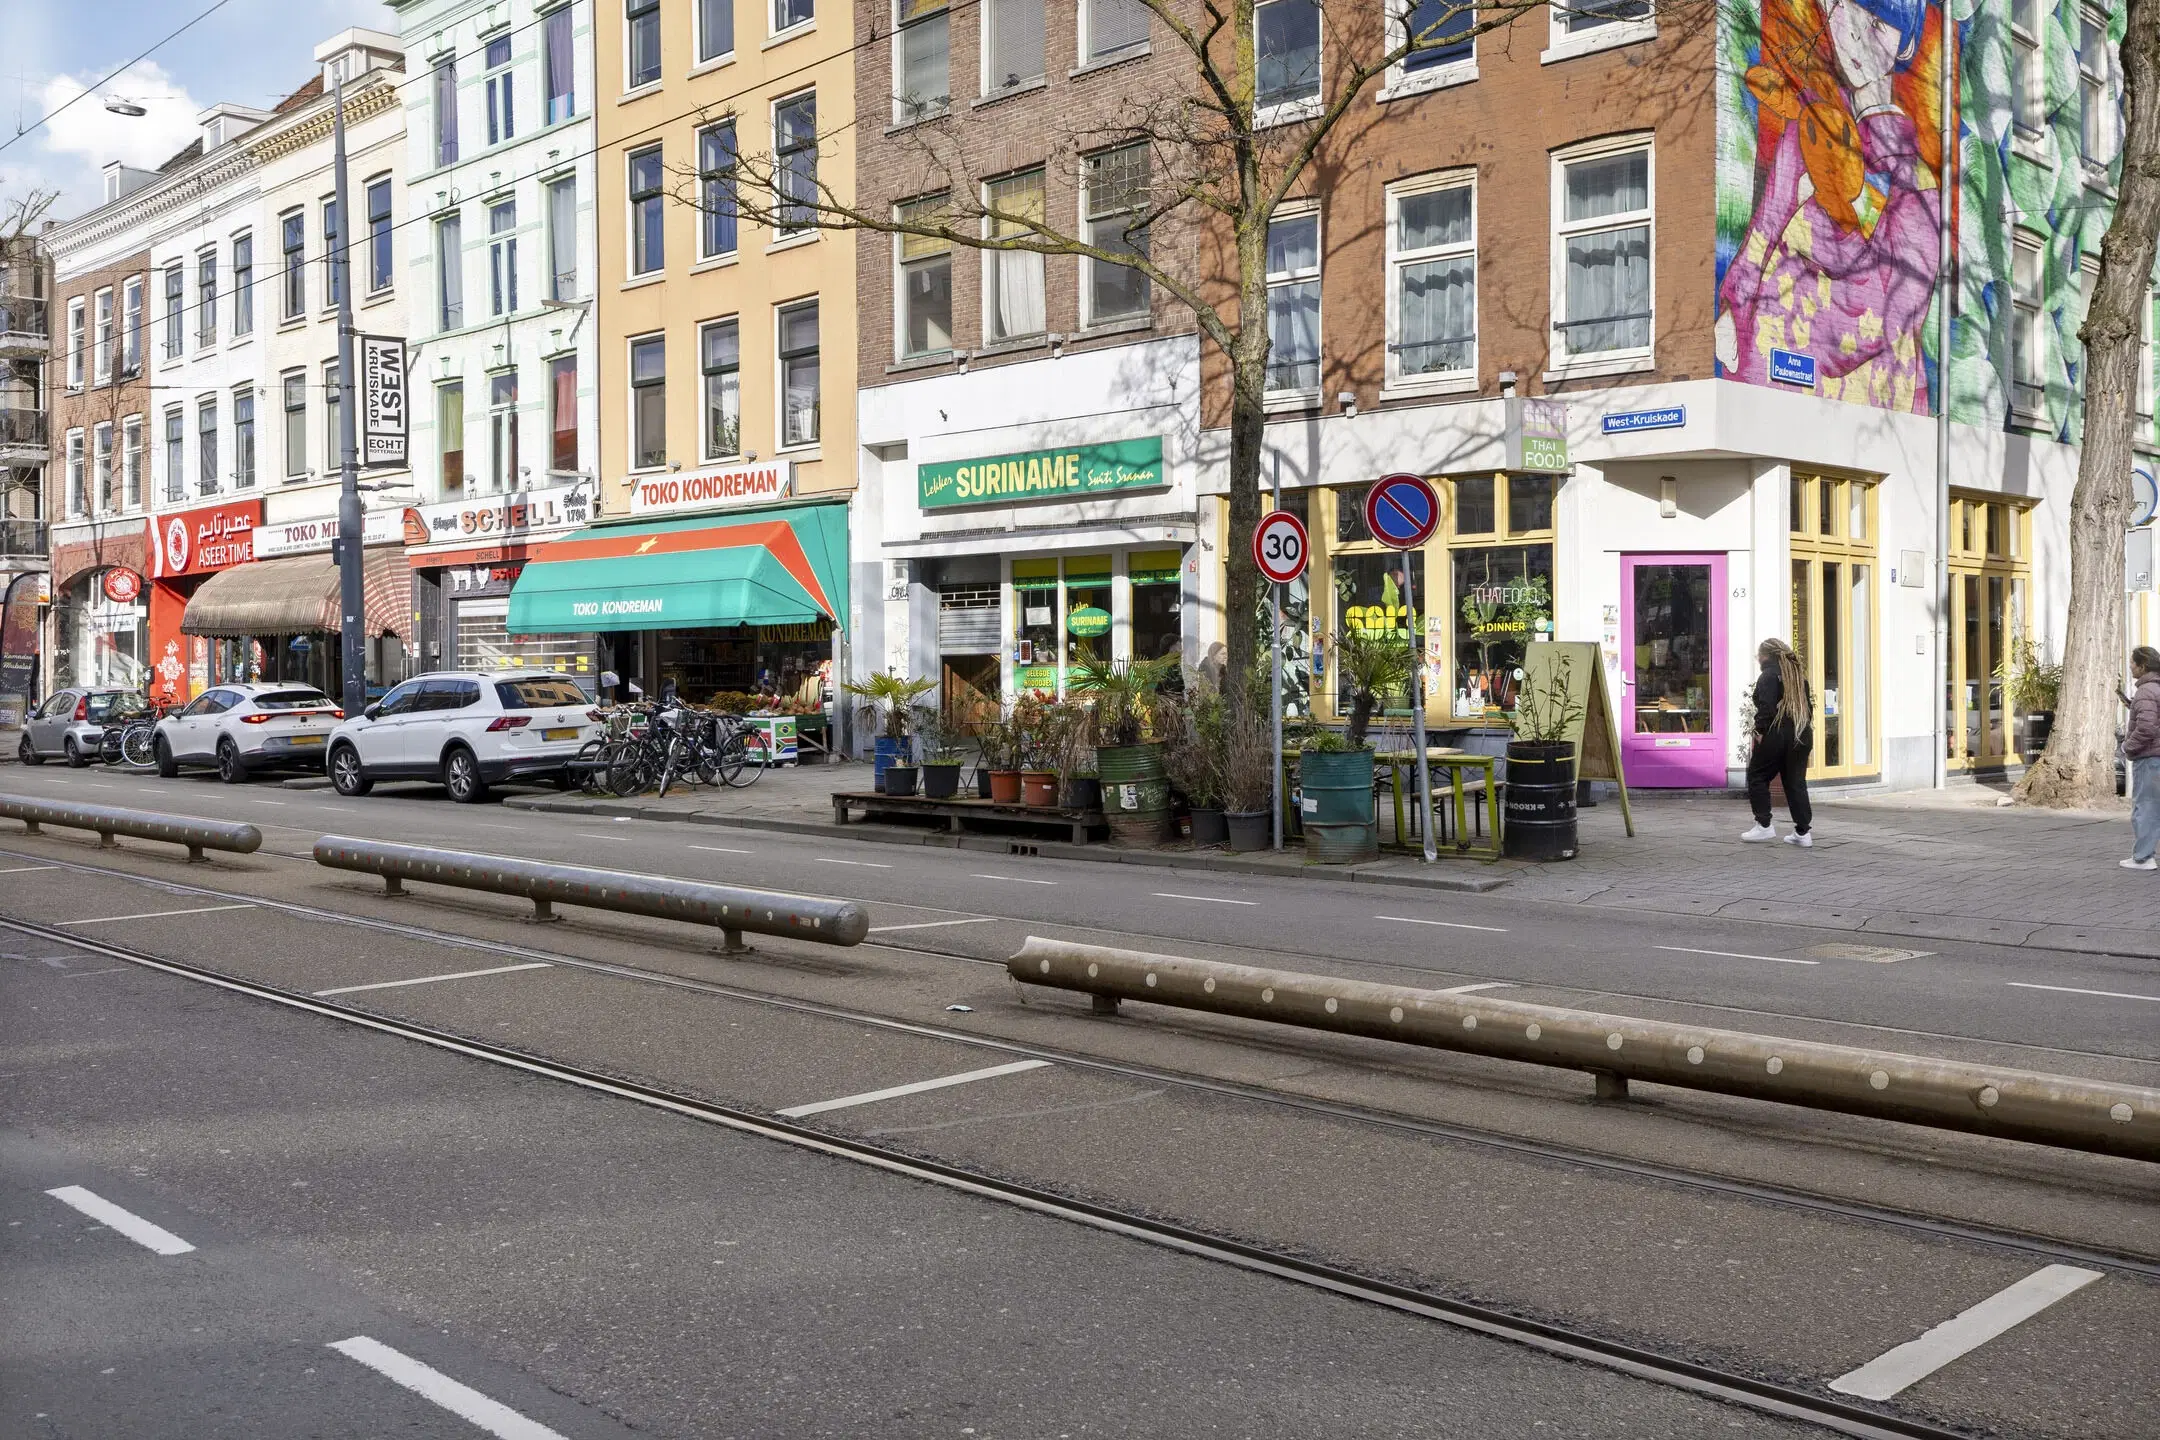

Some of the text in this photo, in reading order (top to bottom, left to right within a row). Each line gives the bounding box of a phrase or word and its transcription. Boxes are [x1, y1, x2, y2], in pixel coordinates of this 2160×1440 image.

[1788, 355, 1802, 367] Anna
[1774, 364, 1813, 382] Paulownastraat
[369, 346, 380, 428] KRUISKADE
[380, 348, 402, 428] WEST
[1607, 411, 1679, 428] West-Kruiskade
[369, 439, 403, 450] ECHT
[1531, 440, 1556, 451] THAI
[1525, 452, 1566, 468] FOOD
[923, 474, 953, 498] Lekker
[956, 453, 1080, 498] SURINAME
[1116, 465, 1154, 484] Sranan
[641, 468, 777, 506] TOKO KONDREMAN
[460, 500, 562, 534] SCHELL
[284, 524, 317, 543] TOKO
[198, 545, 227, 567] ASEER
[227, 541, 252, 563] TIME
[475, 550, 500, 560] SCHELL
[1265, 533, 1299, 561] 30
[1732, 588, 1747, 598] 63
[573, 599, 663, 616] TOKO KONDREMAN
[1071, 615, 1108, 627] SURINAME
[1487, 622, 1526, 633] DINNER
[759, 621, 833, 643] KONDREMAN
